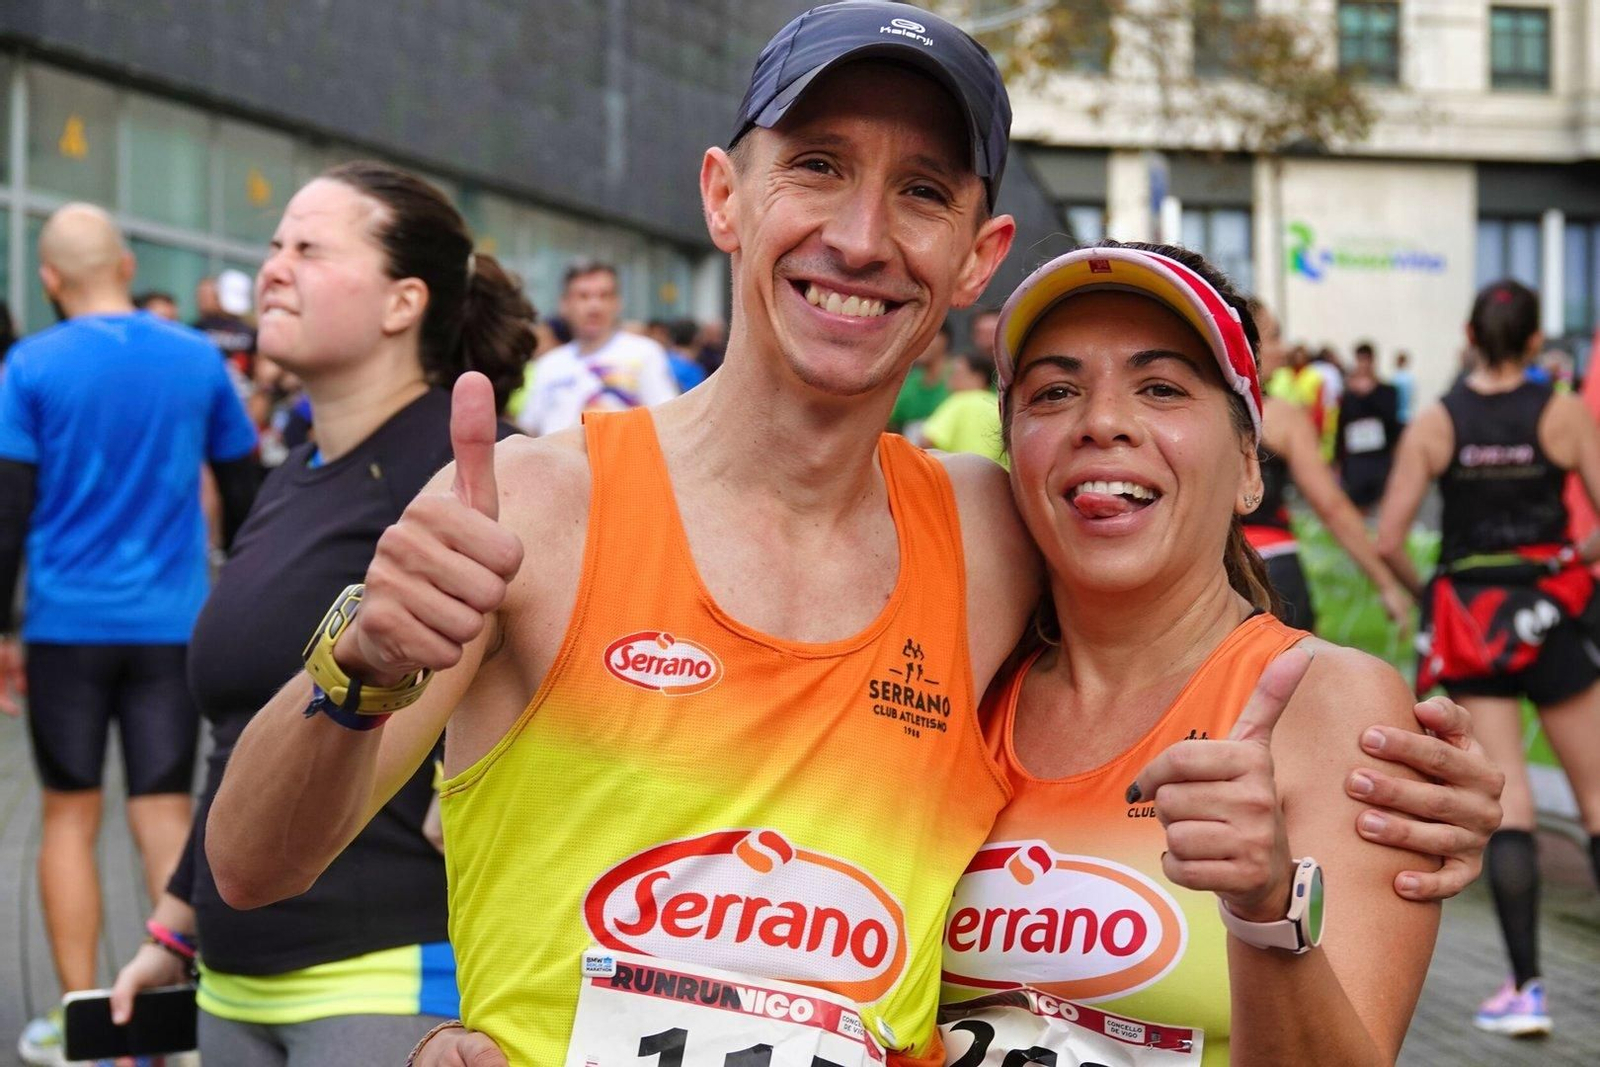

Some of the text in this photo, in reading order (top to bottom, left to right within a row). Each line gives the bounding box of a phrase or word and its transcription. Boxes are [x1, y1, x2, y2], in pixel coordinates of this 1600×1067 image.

[614, 645, 711, 678] Serrano
[869, 680, 950, 717] SERRANO
[873, 704, 947, 732] CLUB ATLETISMO
[613, 870, 888, 968] Serrano
[942, 907, 1147, 957] errano
[1107, 1020, 1142, 1033] CONCELLO
